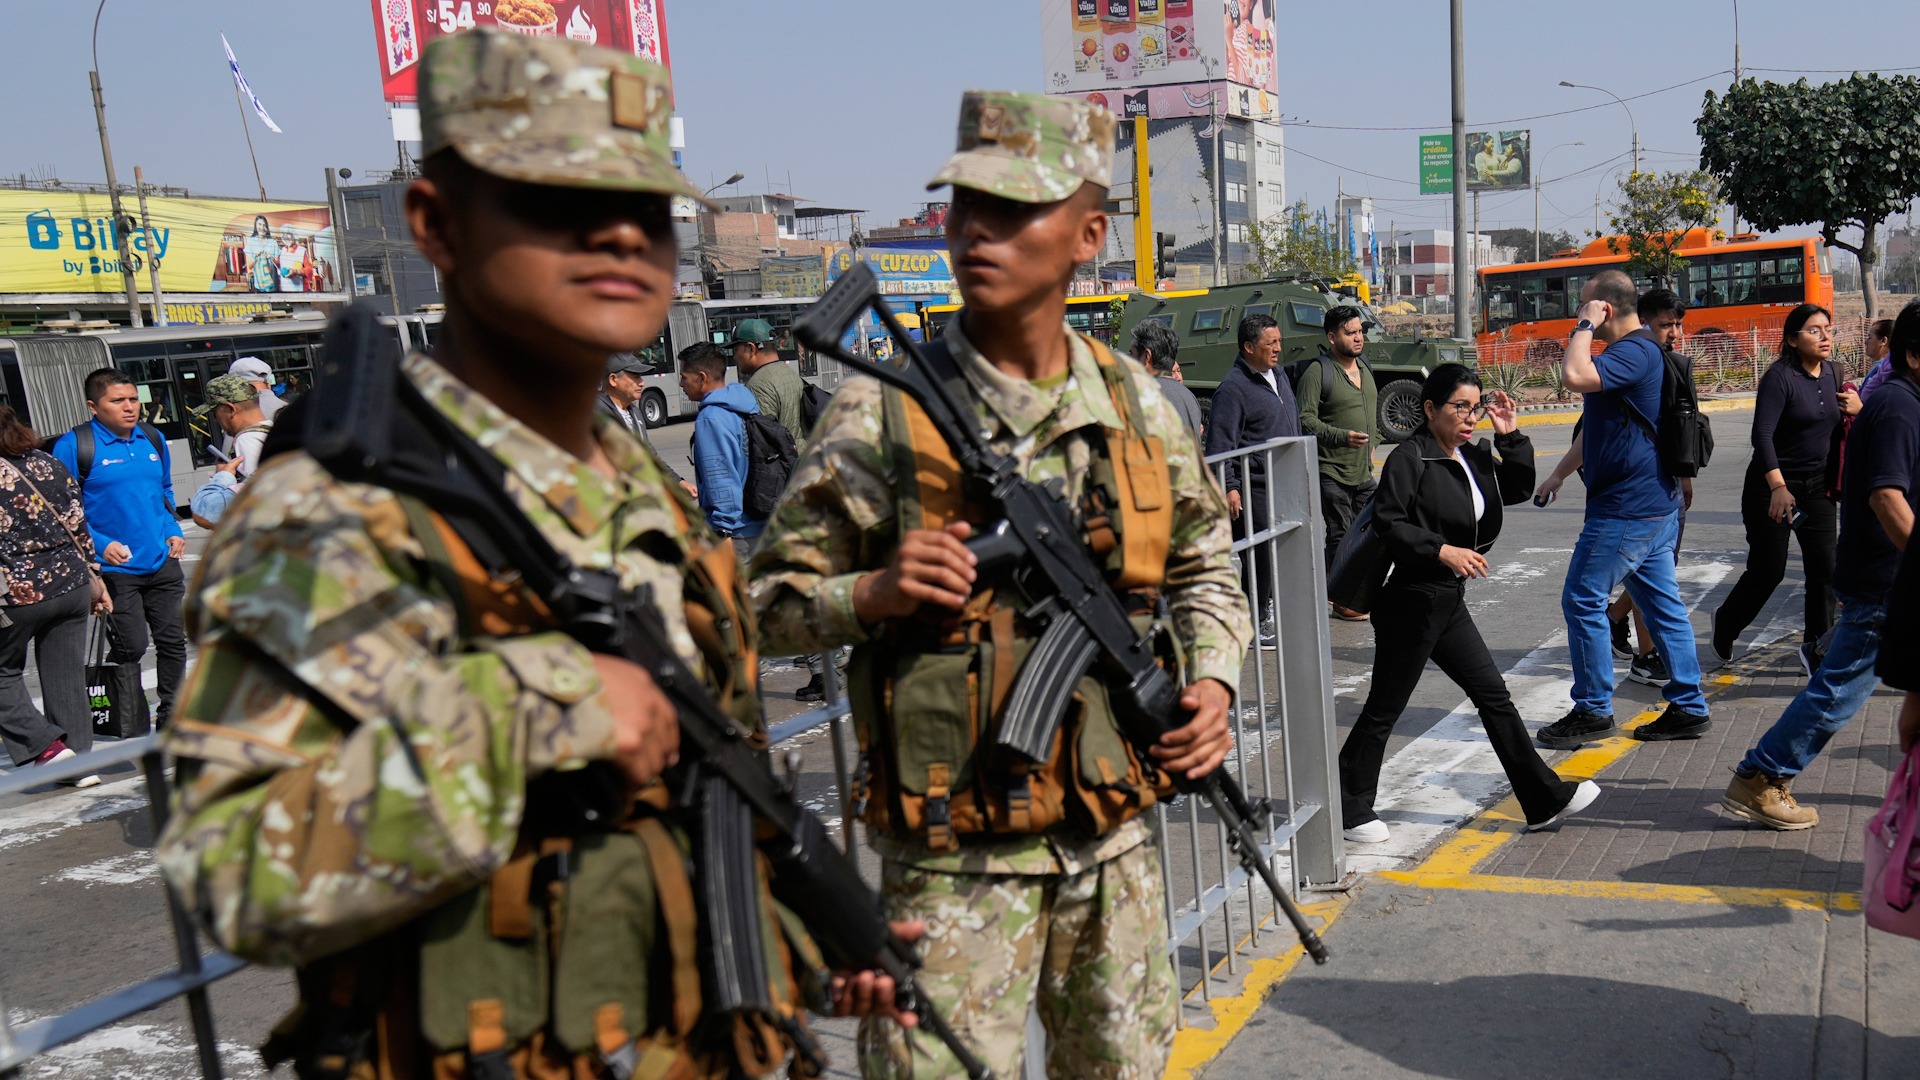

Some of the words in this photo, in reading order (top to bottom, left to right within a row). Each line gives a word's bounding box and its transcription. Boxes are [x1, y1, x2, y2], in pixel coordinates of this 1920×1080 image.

[1079, 3, 1095, 11] Valle
[1110, 5, 1127, 13] Valle
[438, 0, 476, 33] 54
[1126, 103, 1147, 112] Valle
[63, 259, 83, 276] by
[103, 258, 140, 273] bitl
[205, 304, 215, 322] Y
